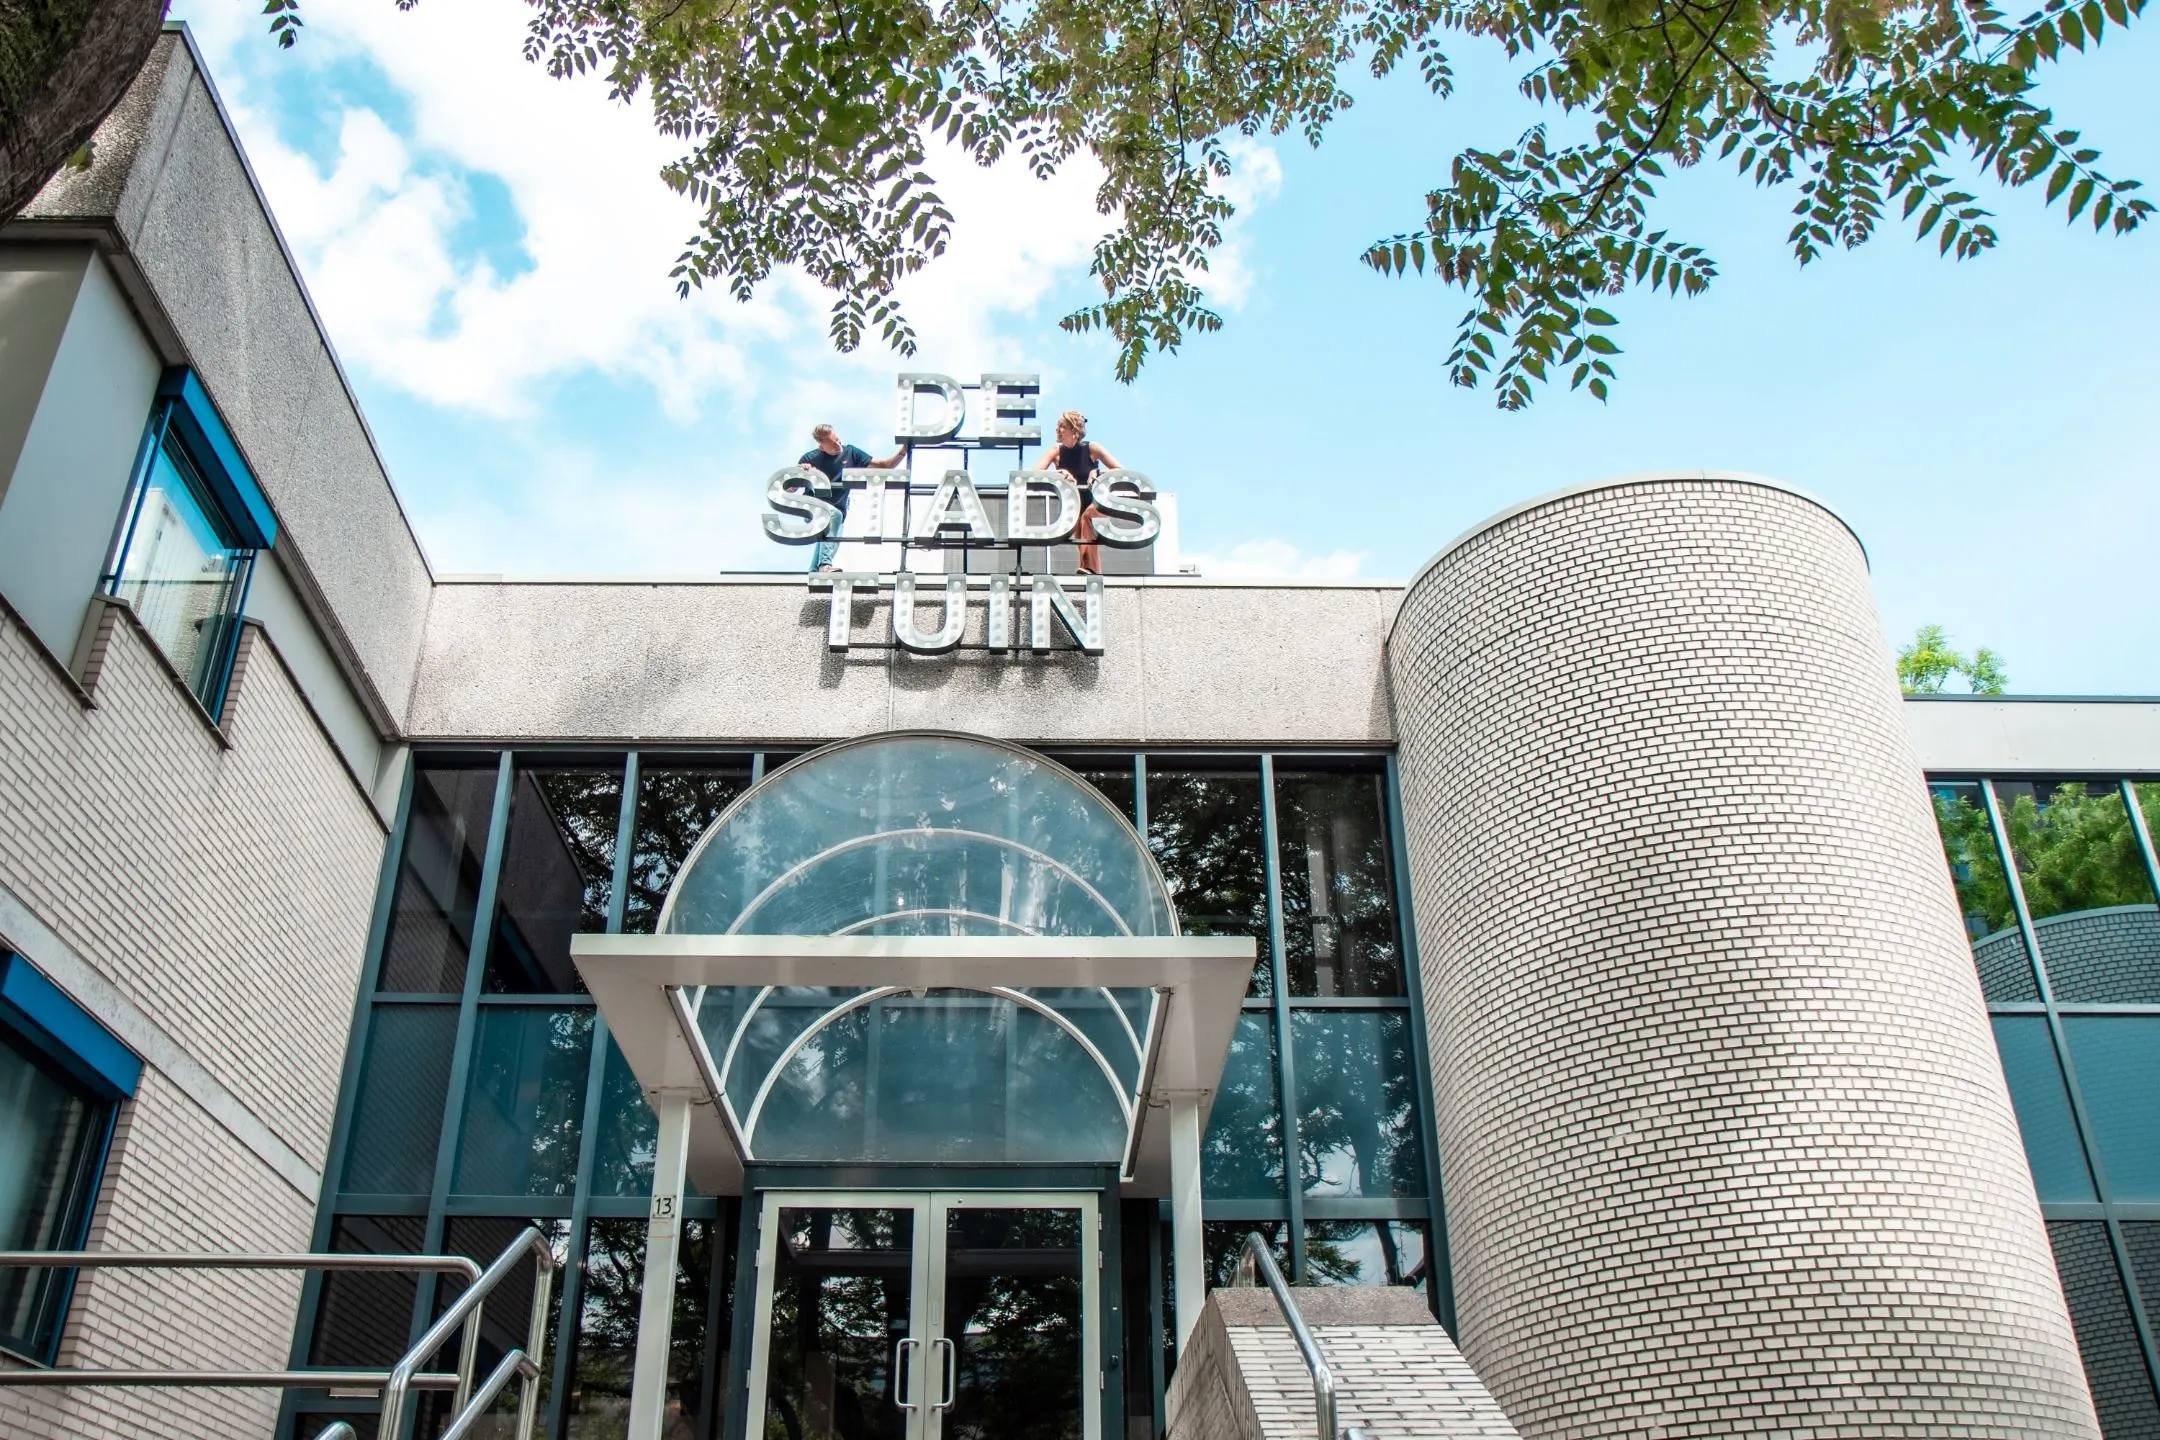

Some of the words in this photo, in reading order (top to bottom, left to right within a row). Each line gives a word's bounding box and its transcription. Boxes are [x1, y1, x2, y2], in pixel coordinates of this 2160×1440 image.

[895, 373, 1041, 446] DE
[762, 466, 1161, 549] STADS
[808, 572, 1104, 656] TUIN
[656, 1197, 672, 1215] 13
